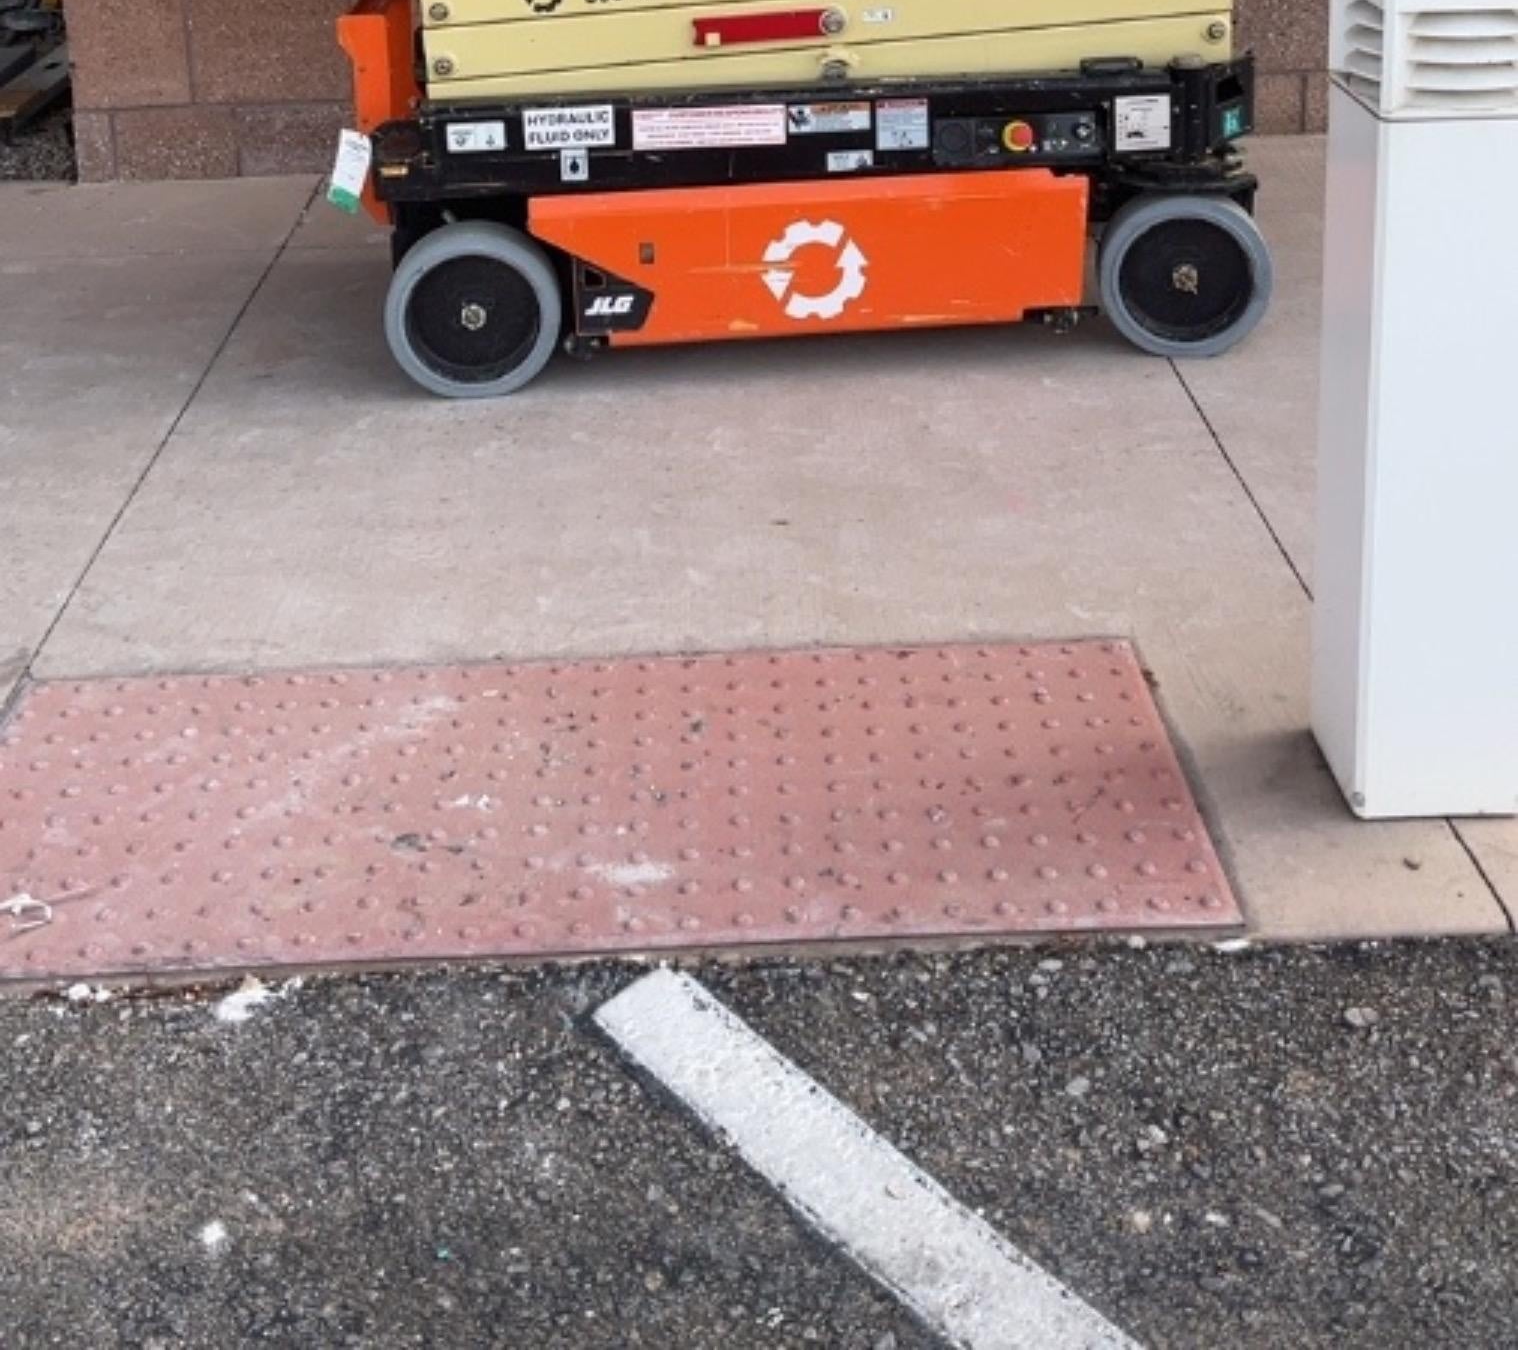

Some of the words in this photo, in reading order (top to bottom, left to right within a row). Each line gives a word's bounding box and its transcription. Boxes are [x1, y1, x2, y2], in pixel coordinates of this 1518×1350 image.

[527, 110, 610, 127] HYDRAULIC
[529, 131, 571, 146] FLUID
[572, 128, 610, 142] ONLY
[584, 294, 635, 317] JLG
